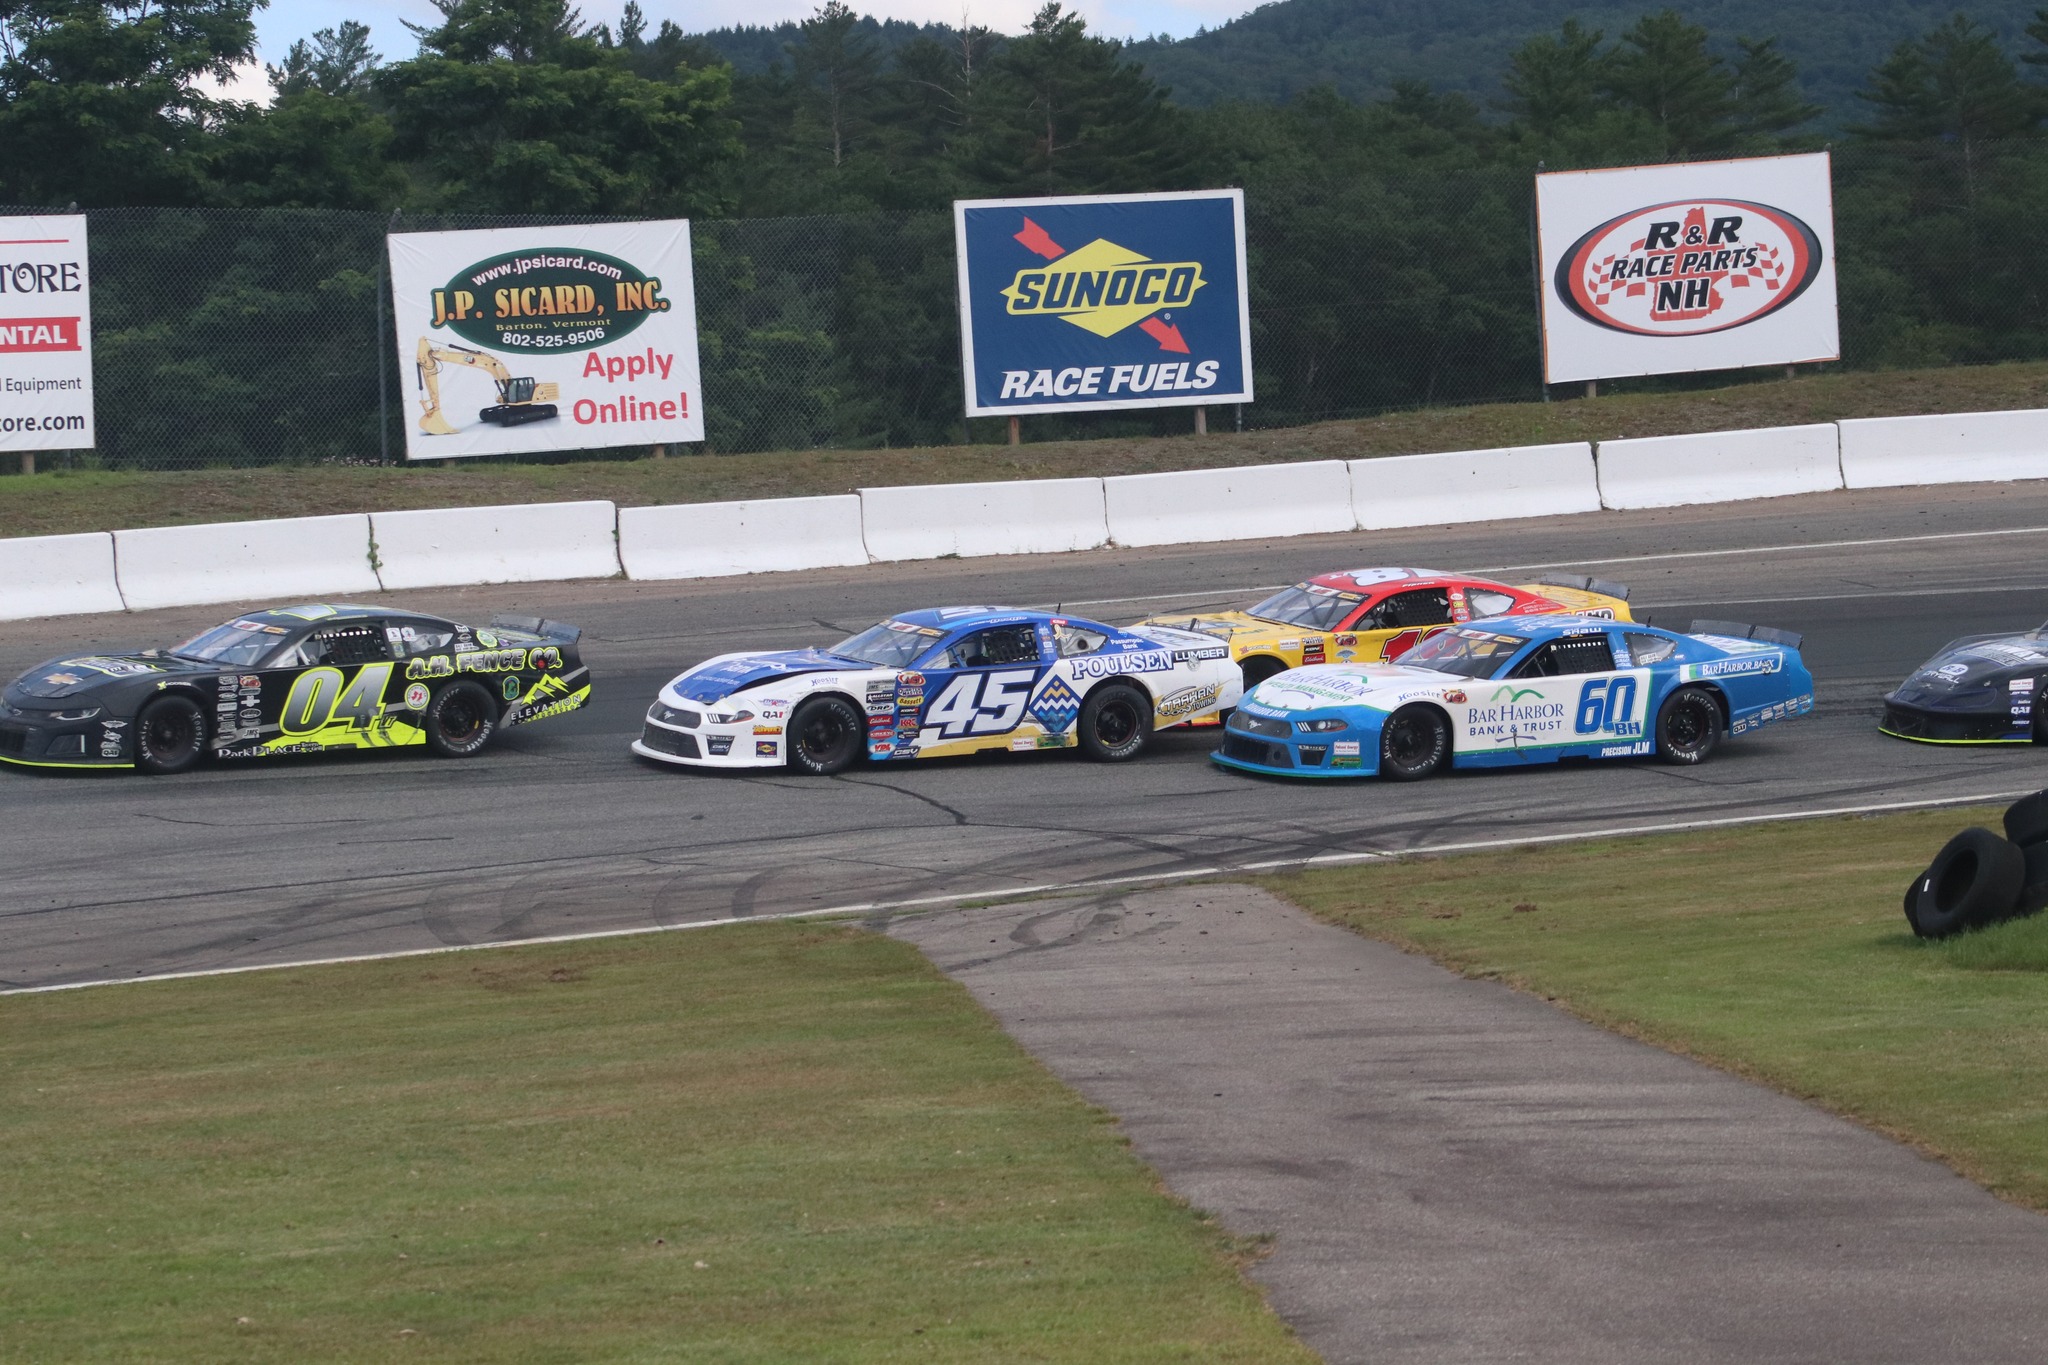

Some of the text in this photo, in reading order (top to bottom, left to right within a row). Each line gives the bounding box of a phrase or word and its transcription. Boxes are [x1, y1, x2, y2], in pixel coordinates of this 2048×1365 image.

[471, 254, 622, 286] www.jpsicard.com
[1609, 247, 1758, 280] RACE PARTS
[434, 280, 668, 325] J.P. SICARD, INC.
[1012, 267, 1196, 310] SUNOCO
[1657, 278, 1710, 312] NH
[502, 328, 605, 347] 802-525-9506
[552, 318, 611, 328] Vermont
[582, 347, 673, 382] Apply
[1000, 360, 1220, 399] RACE FUELS
[6, 377, 82, 394] Equipment
[573, 392, 689, 424] Online!
[406, 655, 454, 680] A.H.
[456, 649, 527, 673] FENCE
[1072, 649, 1225, 679] POULSEN LUMBER
[279, 662, 395, 737] 04
[510, 694, 582, 721] ELEVATION
[922, 669, 1037, 737] 45
[1192, 696, 1216, 711] TOWING
[1398, 690, 1440, 702] Hoosier
[1573, 675, 1638, 735] 60
[1468, 703, 1564, 724] BAR HARBOR
[1469, 720, 1563, 736] BANK & TRUST
[1614, 722, 1641, 736] BH
[1601, 742, 1650, 756] PRECISION JLM
